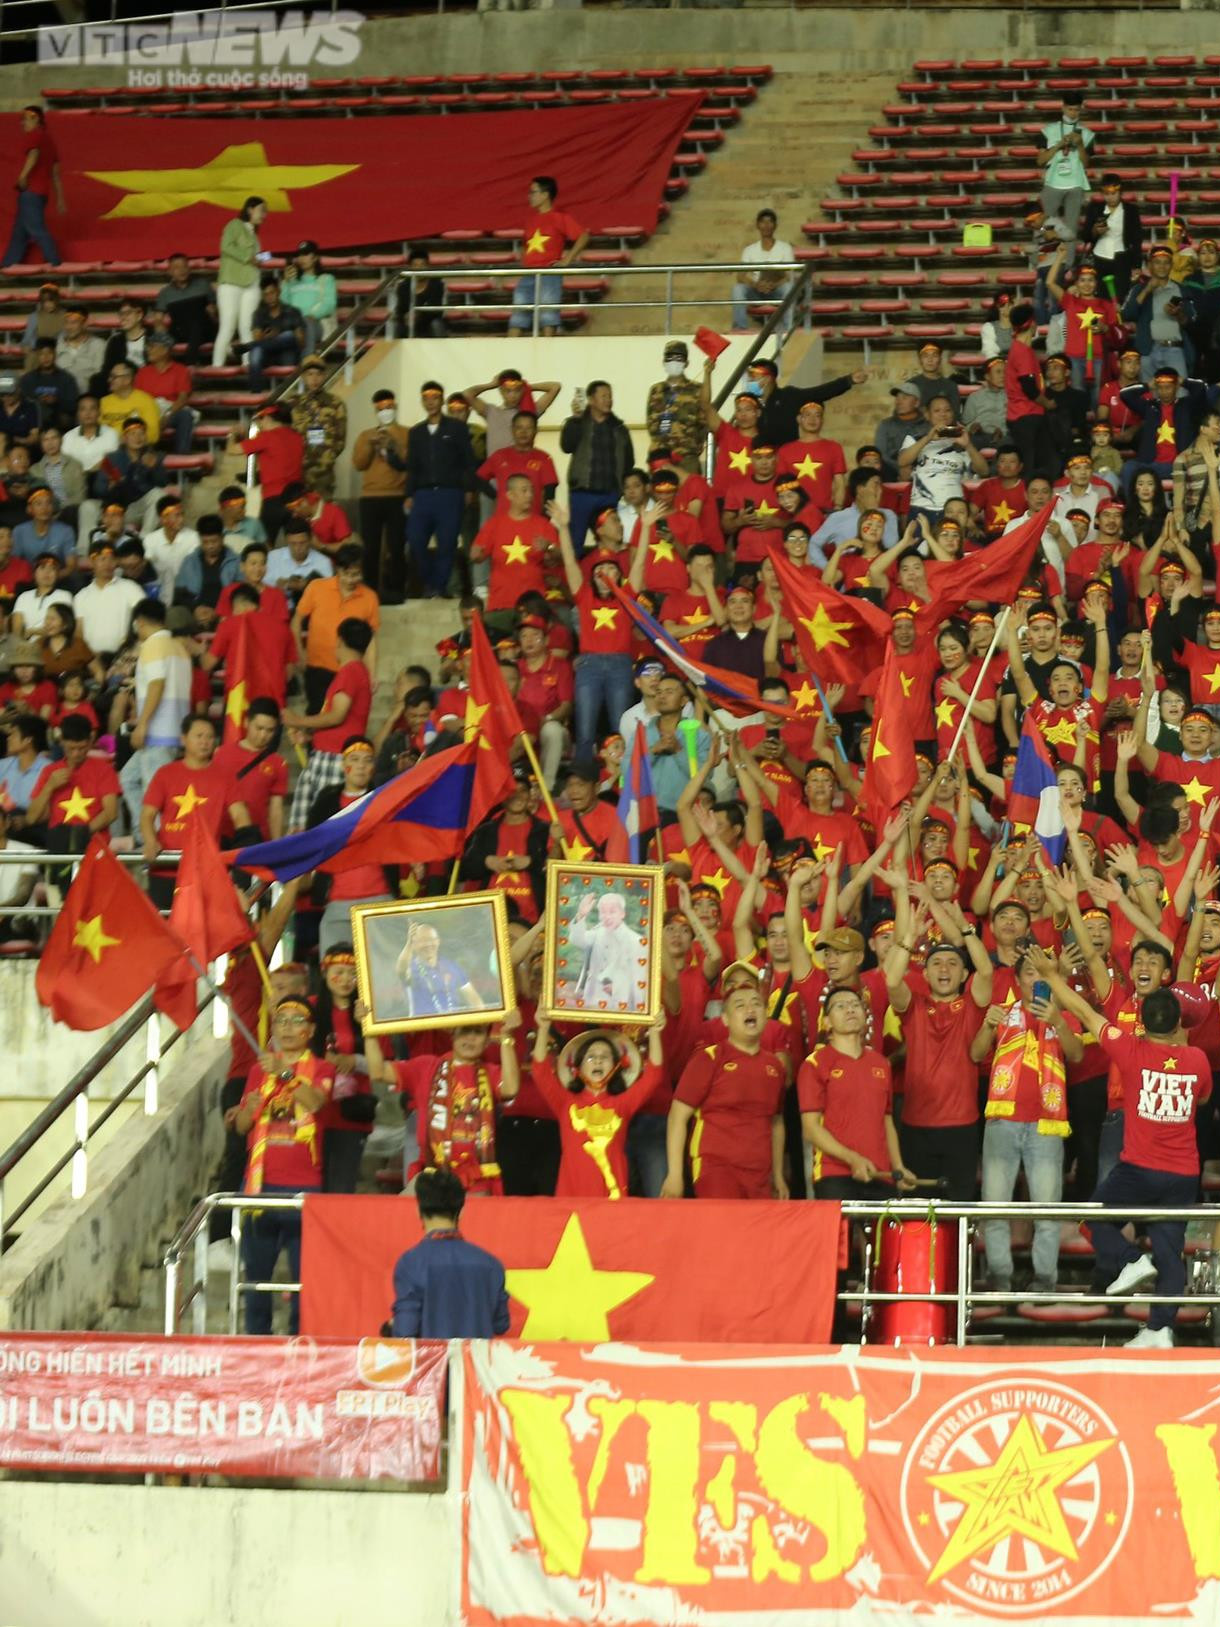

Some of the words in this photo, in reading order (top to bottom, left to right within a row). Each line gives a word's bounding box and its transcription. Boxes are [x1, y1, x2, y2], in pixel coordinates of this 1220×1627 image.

[1141, 1069, 1197, 1095] VIET
[1137, 1089, 1193, 1116] NAM
[28, 1389, 135, 1434] LUÔN
[146, 1391, 227, 1437] BÊN
[237, 1400, 325, 1448] BẠN
[919, 1399, 987, 1470] FOOTBALL
[990, 1390, 1099, 1436] SUPPORTERS
[966, 1572, 1026, 1601] SINCE
[1031, 1569, 1073, 1598] 2014
